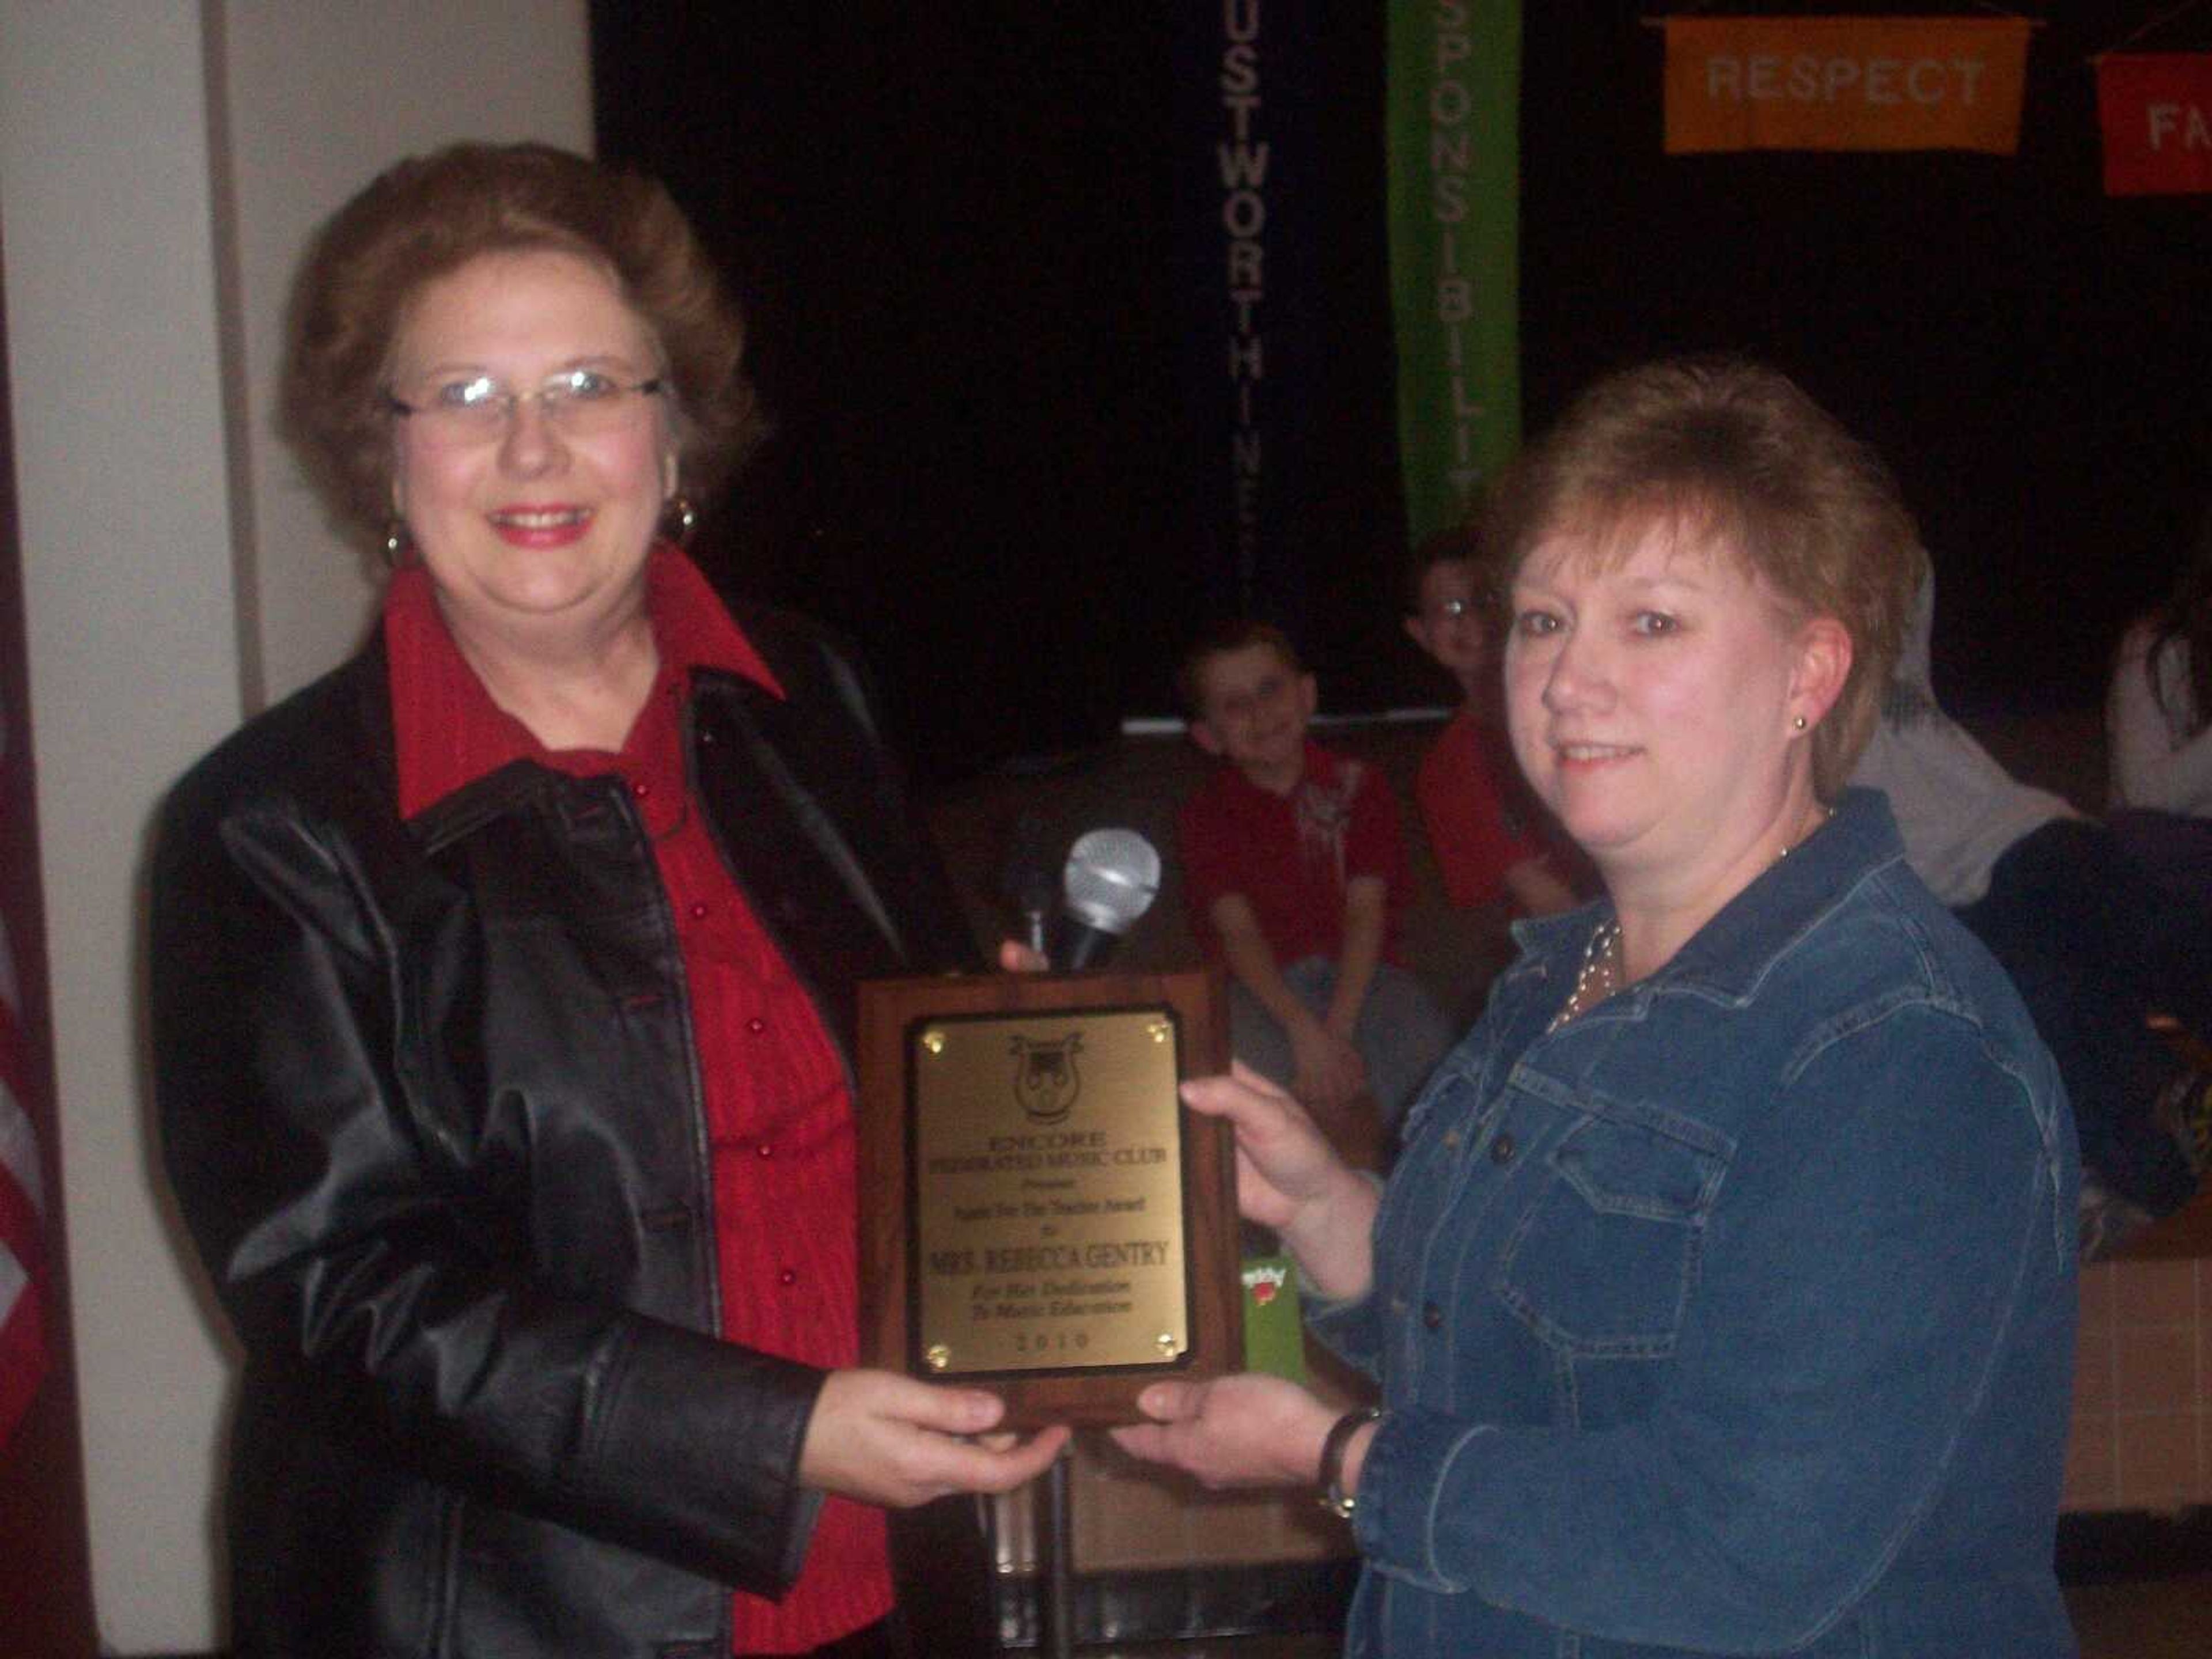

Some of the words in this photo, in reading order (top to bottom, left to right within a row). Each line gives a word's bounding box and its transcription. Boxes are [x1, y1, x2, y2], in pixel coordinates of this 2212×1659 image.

[1705, 54, 1986, 108] RESPECT
[988, 1131, 1107, 1152] ENCORE
[1112, 1146, 1168, 1165] CLUB
[983, 1245, 1082, 1274] REBECCA
[1085, 1240, 1169, 1268] GENTRY
